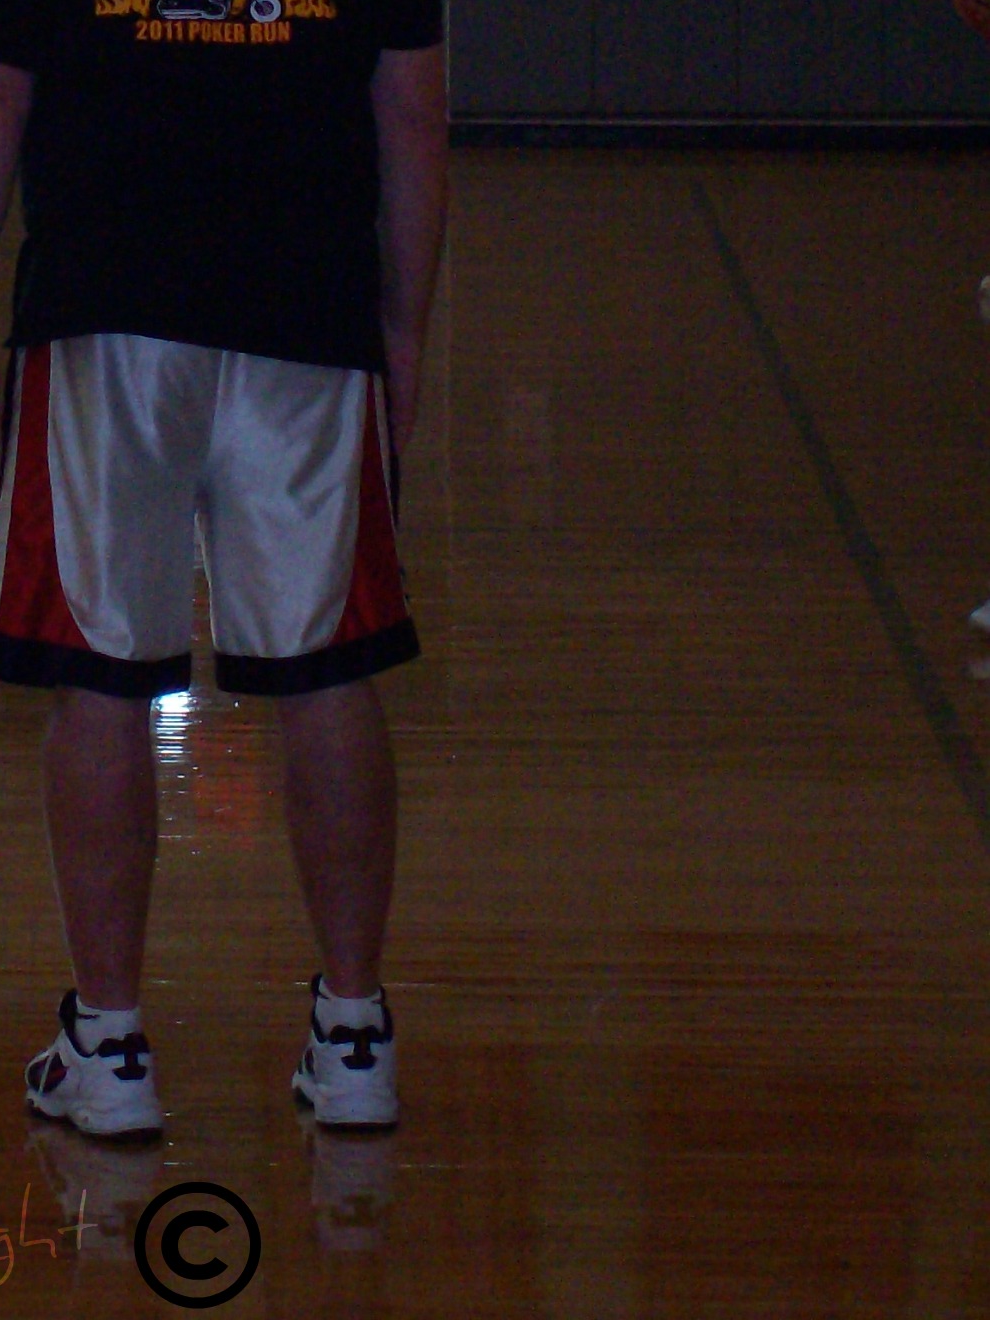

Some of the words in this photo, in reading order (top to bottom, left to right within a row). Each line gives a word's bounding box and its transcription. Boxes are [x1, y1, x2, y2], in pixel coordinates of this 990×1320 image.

[135, 19, 185, 43] 2011
[188, 21, 246, 45] POKER
[250, 21, 291, 45] RUN
